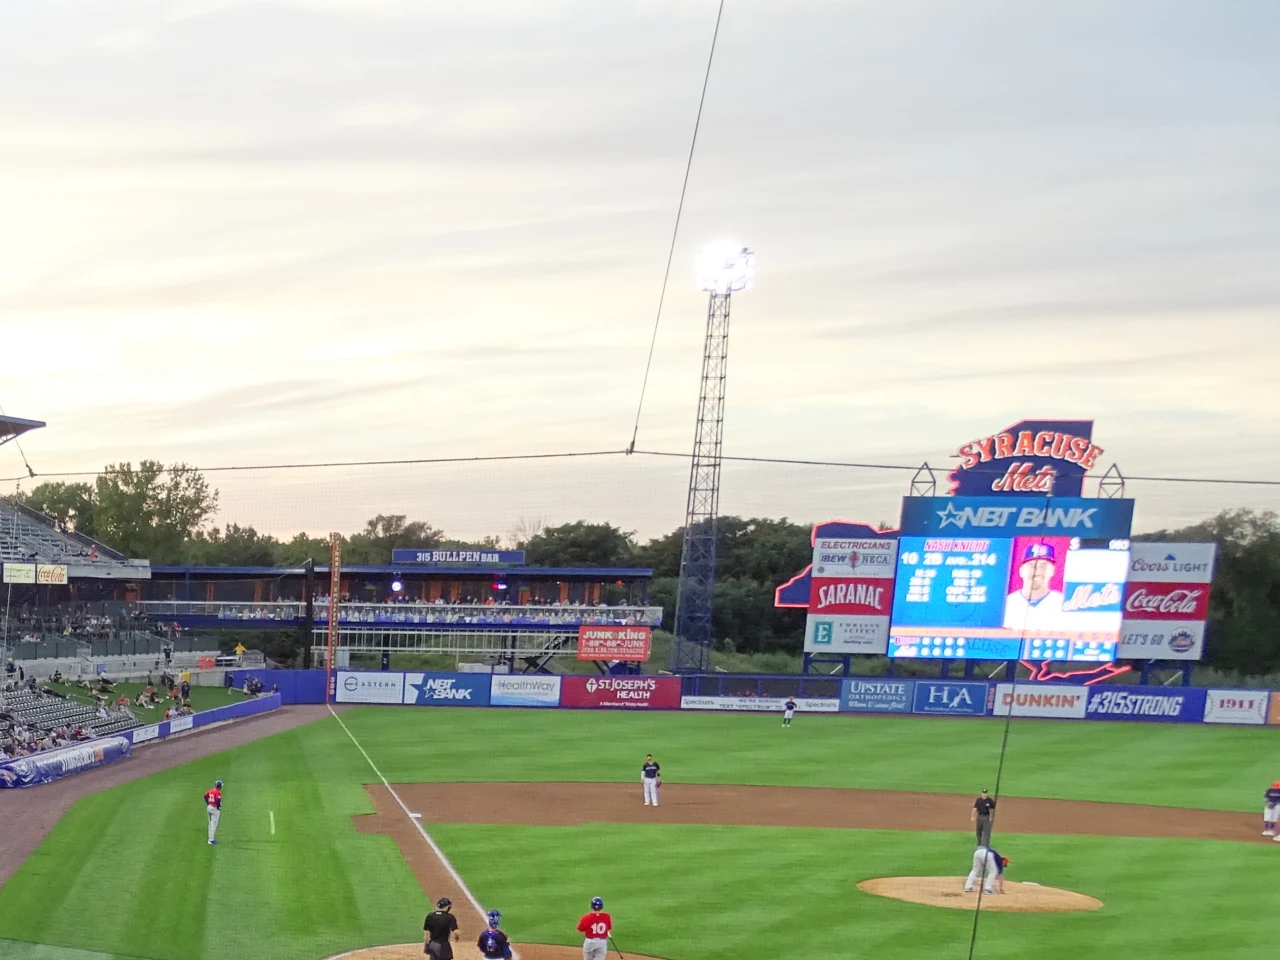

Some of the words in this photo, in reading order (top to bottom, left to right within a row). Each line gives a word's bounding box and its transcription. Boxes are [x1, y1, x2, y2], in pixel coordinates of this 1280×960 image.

[958, 430, 1104, 470] SYRACUSE
[991, 462, 1058, 491] Mets
[959, 506, 1017, 528] NBT
[1016, 507, 1098, 529] BANK
[820, 541, 892, 550] ELECTRICIANS
[416, 552, 431, 562] 315
[432, 551, 481, 562] BULLPEN
[480, 553, 499, 563] BAR
[821, 554, 848, 563] IBEW
[861, 554, 888, 564] NECA
[1131, 558, 1169, 572] Coors
[1173, 563, 1208, 573] LIGHT
[817, 583, 884, 610] SARANAC
[582, 631, 613, 640] JUNK
[618, 628, 646, 640] KING
[1122, 634, 1148, 646] LET'S
[1150, 634, 1165, 646] GO
[426, 679, 456, 689] NBT
[498, 679, 556, 692] HealthWay
[850, 681, 906, 695] UPSTATE
[434, 689, 472, 700] BANK
[617, 690, 651, 699] HEALTH
[1001, 692, 1081, 708] DUNKIN'
[1087, 691, 1184, 716] #315STRONG
[1219, 698, 1255, 710] 1911
[590, 922, 607, 935] 10
